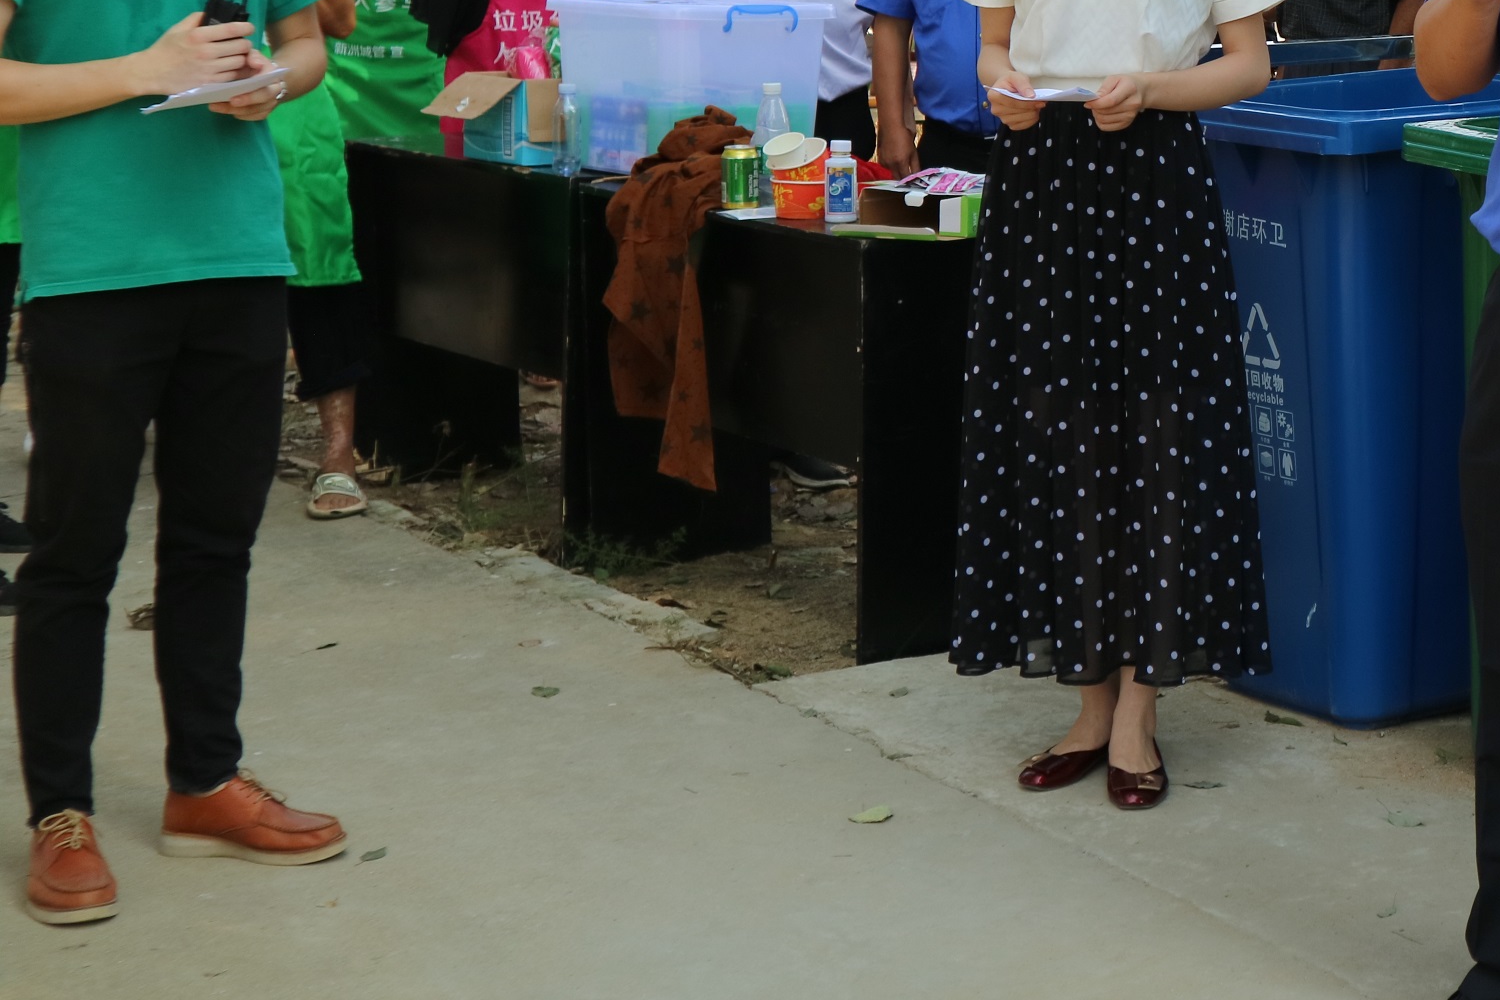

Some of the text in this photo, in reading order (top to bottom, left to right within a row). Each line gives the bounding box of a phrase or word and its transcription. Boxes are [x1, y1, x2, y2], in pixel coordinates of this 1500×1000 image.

[1223, 208, 1287, 249] 谢店环卫
[1247, 390, 1284, 406] ecyclable
